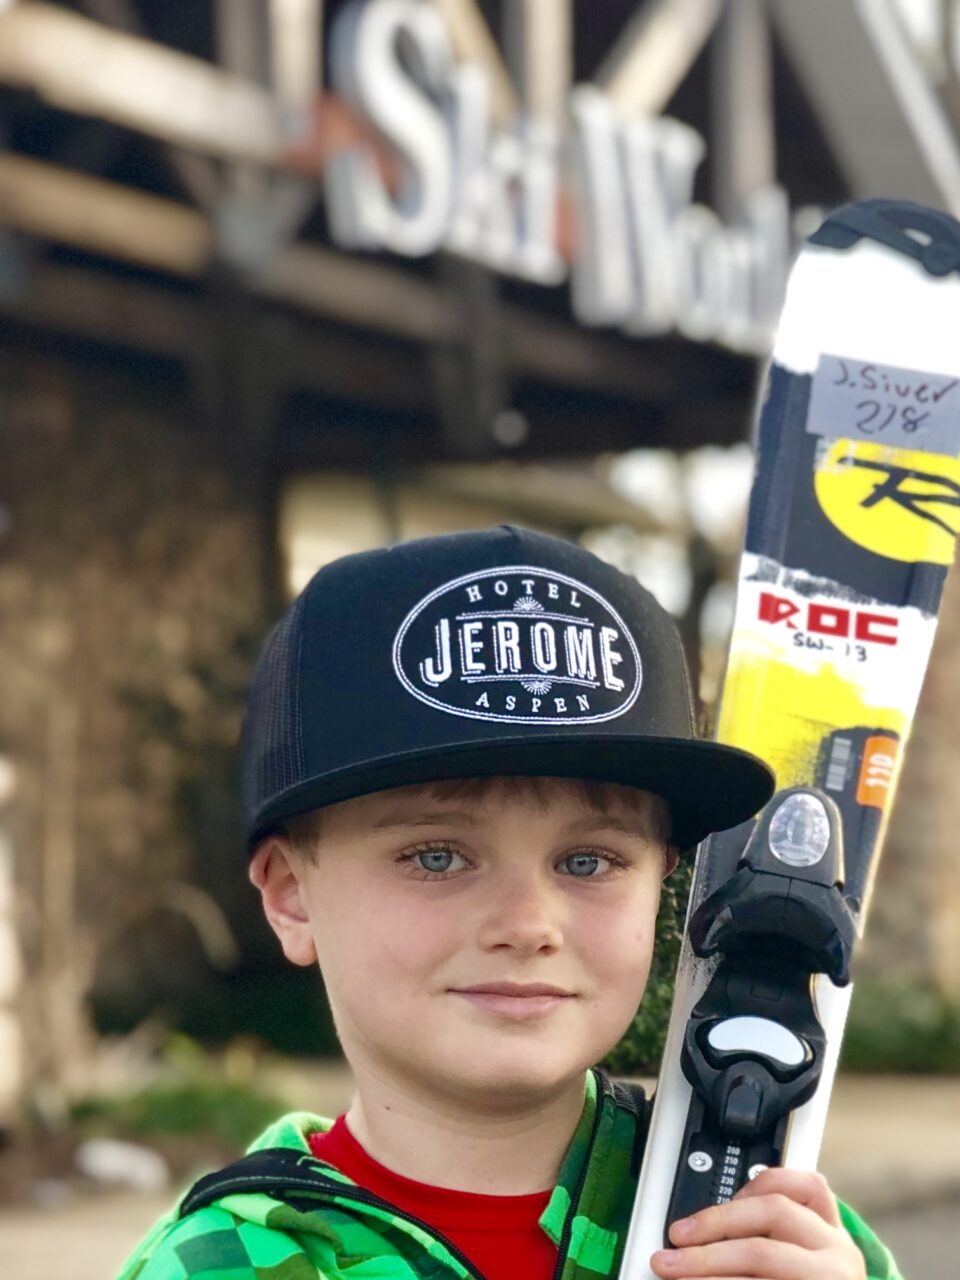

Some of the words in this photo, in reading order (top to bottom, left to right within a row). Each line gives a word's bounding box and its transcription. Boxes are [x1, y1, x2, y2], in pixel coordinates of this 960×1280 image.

[466, 580, 580, 608] HOTEL
[758, 592, 898, 646] ROC
[419, 618, 625, 692] JEROME
[475, 691, 591, 713] ASPEN
[719, 1185, 732, 1196] 220
[721, 1175, 734, 1186] 230
